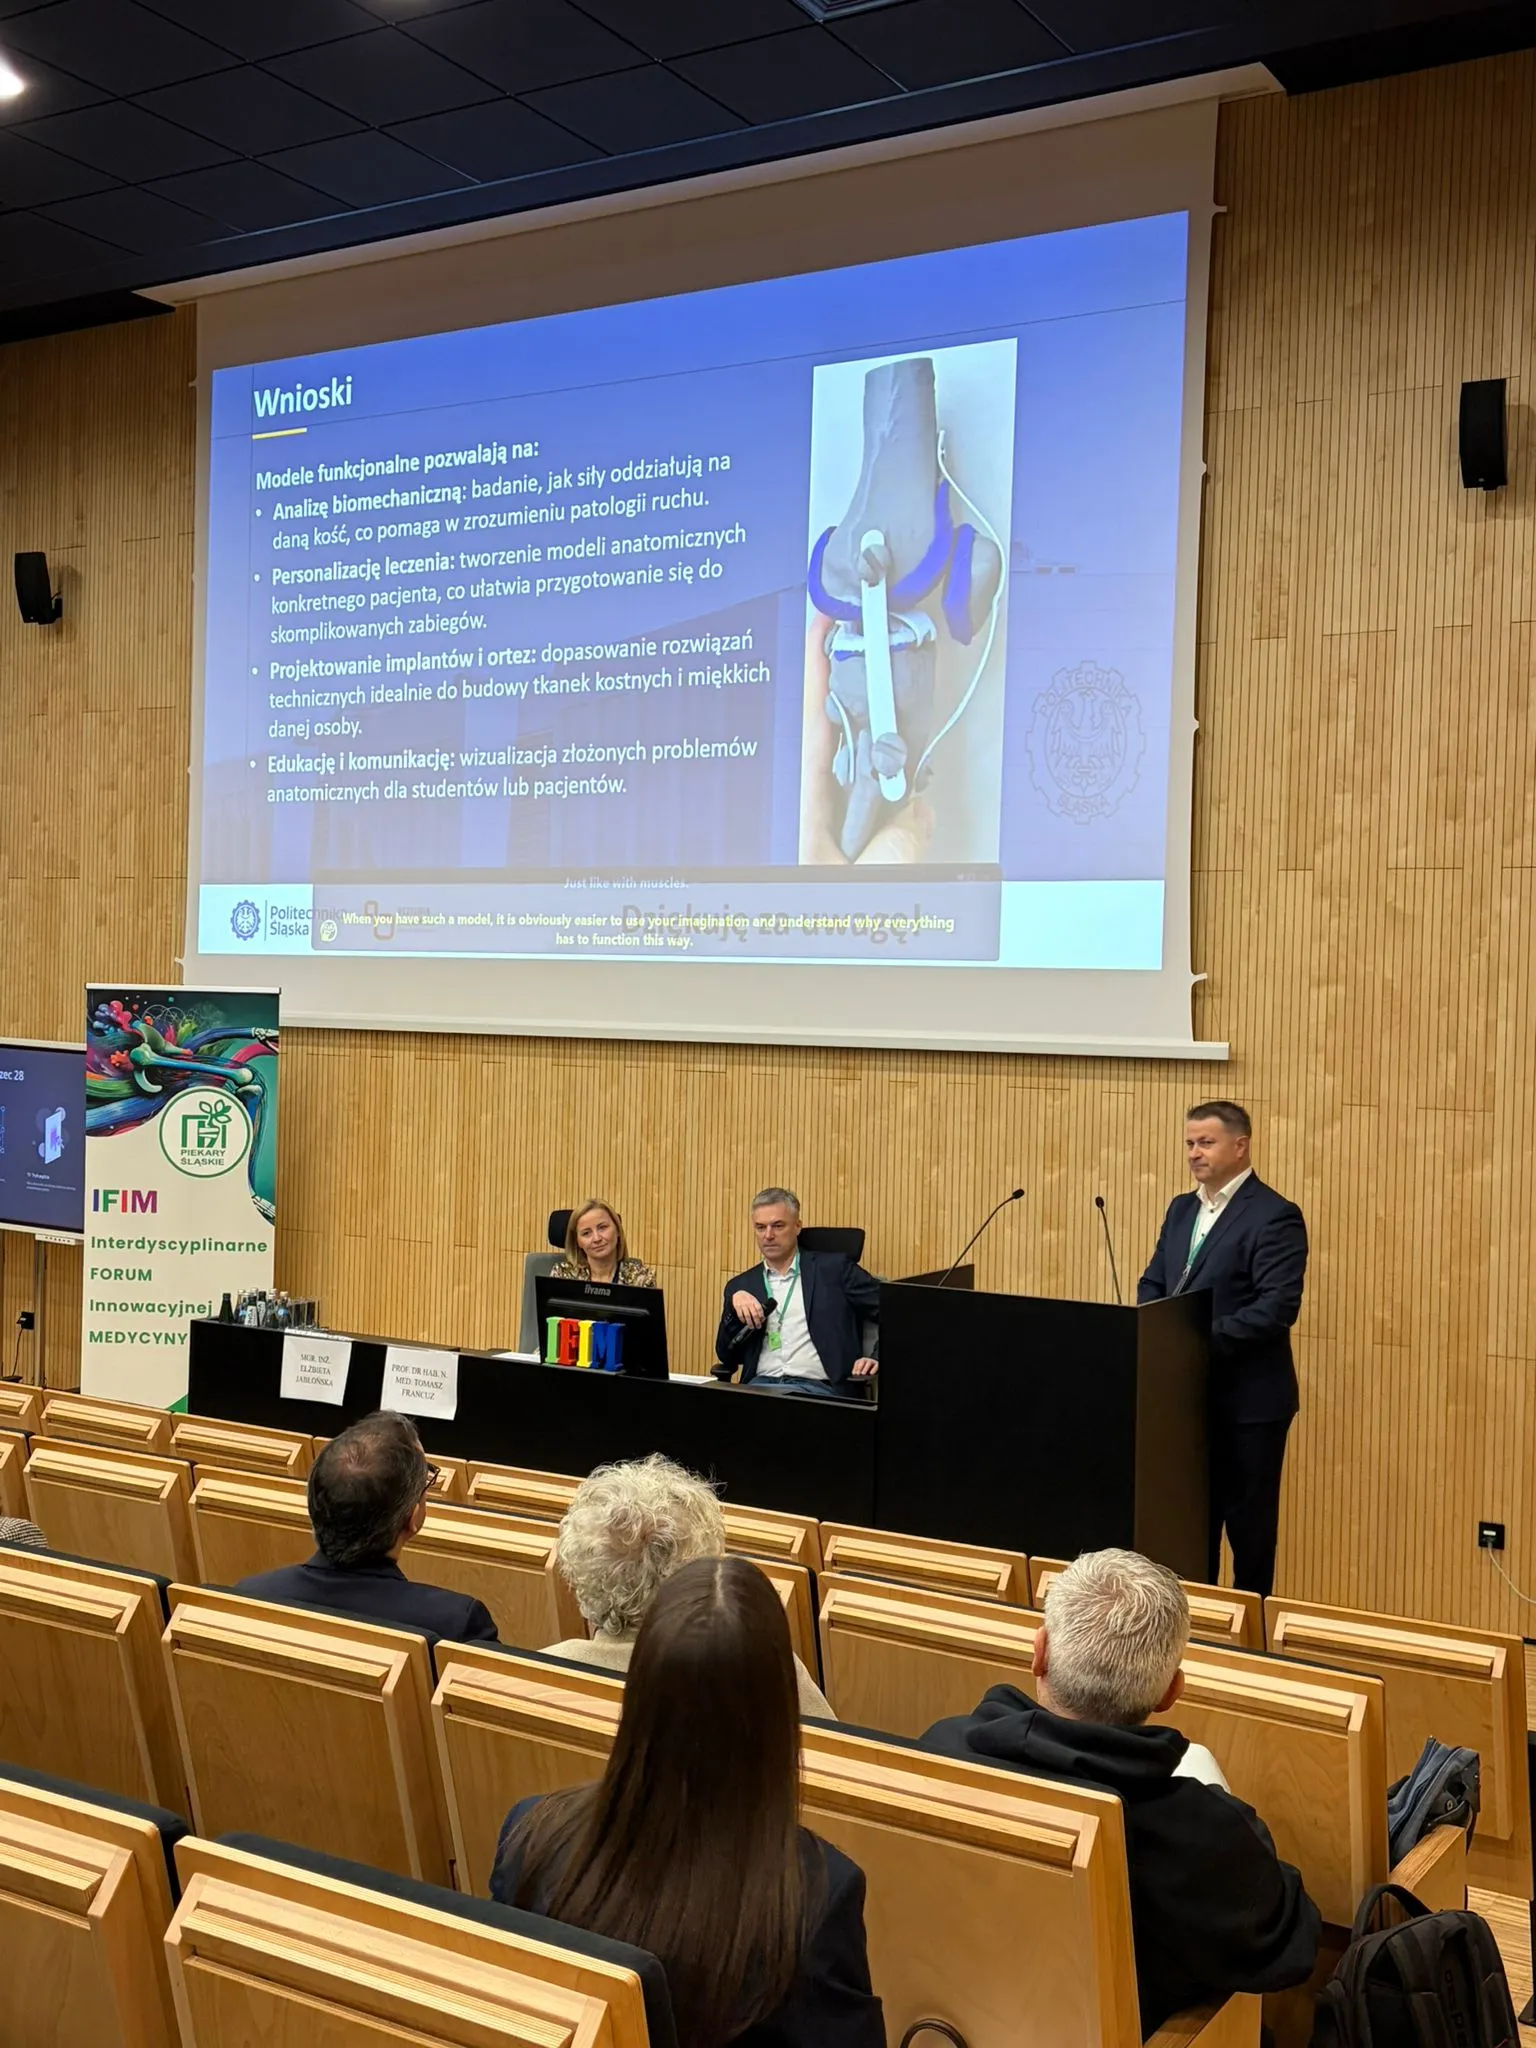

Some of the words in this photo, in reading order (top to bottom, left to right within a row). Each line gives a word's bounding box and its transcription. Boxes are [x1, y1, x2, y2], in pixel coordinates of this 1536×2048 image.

[254, 376, 352, 417] Wnioski
[256, 466, 314, 490] Modele
[318, 455, 420, 481] funkcjonalne
[424, 442, 507, 473] pozwalają
[512, 442, 539, 459] na:
[273, 501, 328, 520] Analizę
[333, 485, 467, 515] biomechaniczną:
[472, 475, 543, 498] badanie,
[547, 469, 572, 493] jak
[577, 465, 605, 488] siły
[611, 454, 702, 483] oddziałują
[708, 455, 731, 472] na
[273, 531, 309, 550] daną
[314, 525, 350, 545] kość,
[355, 525, 373, 540] co
[377, 519, 440, 542] pomaga
[445, 517, 459, 532] w
[463, 503, 565, 531] zrozumieniu
[571, 493, 646, 523] patologii
[652, 488, 709, 511] ruchu.
[272, 559, 380, 586] Personalizację
[386, 552, 454, 575] leczenia:
[459, 544, 542, 568] tworzenie
[547, 536, 606, 561] modeli
[611, 522, 746, 554] anatomicznych
[271, 594, 365, 614] konkretnego
[370, 586, 441, 610] pacjenta,
[447, 584, 465, 600] co
[470, 577, 530, 598] ułatwia
[536, 565, 663, 596] przygotowanie
[669, 562, 693, 584] się
[699, 558, 723, 579] do
[271, 617, 403, 644] skomplikowanych
[409, 611, 487, 635] zabiegów.
[270, 655, 381, 682] Projektowanie
[386, 649, 473, 675] implantów
[478, 648, 483, 666] i
[487, 648, 536, 666] ortez:
[541, 638, 656, 664] dopasowanie
[662, 629, 752, 655] rozwiązań
[269, 686, 365, 709] technicznych
[371, 684, 432, 703] idealnie
[437, 682, 457, 699] do
[462, 678, 528, 699] budowy
[533, 673, 590, 694] tkanek
[596, 668, 672, 692] kostnych
[678, 668, 682, 686] i
[688, 661, 770, 688] miękkich
[269, 720, 310, 739] danej
[314, 717, 362, 738] osoby.
[268, 752, 335, 775] Edukację
[340, 752, 344, 770] i
[349, 749, 455, 775] komunikację:
[460, 745, 556, 767] wizualizacja
[562, 740, 646, 765] złożonych
[652, 736, 758, 764] problemów
[267, 781, 379, 803] anatomicznych
[384, 780, 407, 799] dla
[412, 779, 498, 799] studentów
[503, 777, 528, 796] lub
[534, 774, 626, 799] pacjentów.
[564, 877, 587, 888] Just
[590, 877, 609, 888] like
[613, 876, 636, 888] with
[641, 877, 689, 888] muscles.
[270, 922, 309, 937] Śląska
[342, 912, 371, 925] When
[374, 916, 392, 927] you
[396, 912, 419, 924] have
[422, 913, 445, 924] such
[448, 916, 454, 924] a
[458, 913, 493, 927] model,
[496, 913, 504, 926] it
[507, 914, 515, 926] is
[519, 913, 571, 929] obviously
[574, 915, 607, 926] easier
[611, 916, 622, 927] to
[626, 916, 645, 926] use
[648, 916, 675, 929] your
[678, 914, 749, 930] imagination
[753, 915, 775, 927] and
[780, 915, 850, 928] understand
[854, 915, 881, 931] why
[884, 915, 954, 932] everything
[556, 933, 574, 945] has
[577, 934, 589, 945] to
[592, 933, 640, 946] function
[643, 933, 664, 946] this
[667, 937, 693, 949] way.
[14, 1070, 24, 1081] 28
[181, 1157, 224, 1167] ŚLĄSKIE
[93, 1189, 157, 1213] IFIM
[91, 1236, 267, 1255] Interdyscyplinarne
[91, 1268, 152, 1281] FORUM
[90, 1299, 212, 1318] Innowacyjnej
[89, 1331, 188, 1345] MEDYCYNY
[412, 1366, 421, 1375] DR
[402, 1389, 435, 1400] FRANCUZ
[414, 1379, 443, 1389] TOMASZ
